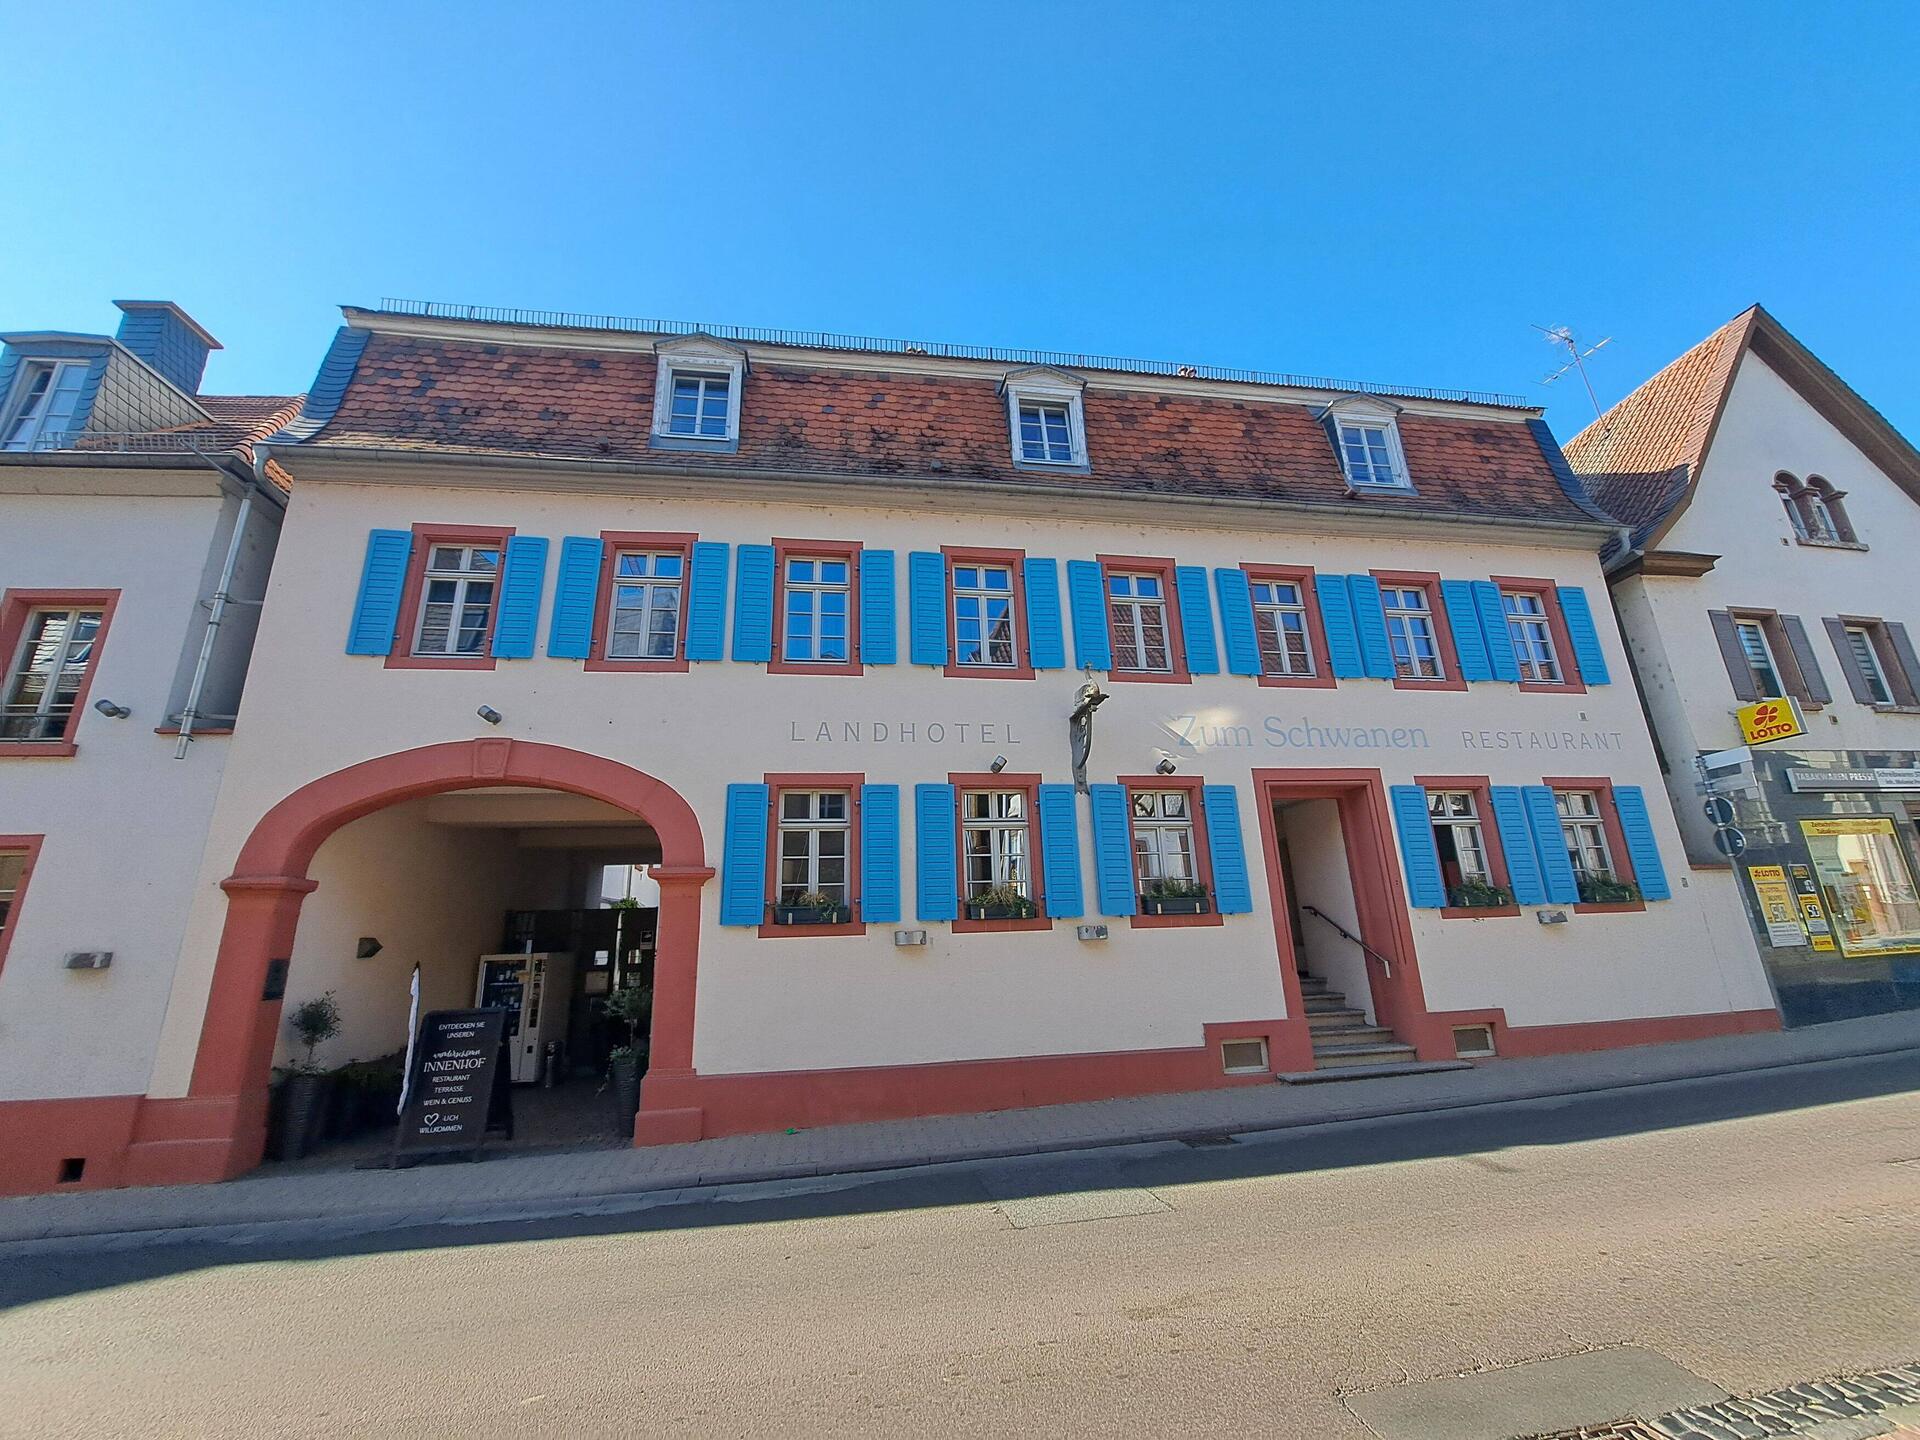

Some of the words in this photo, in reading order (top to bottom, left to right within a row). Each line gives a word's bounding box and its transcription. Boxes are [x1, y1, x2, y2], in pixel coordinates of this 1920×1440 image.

[791, 721, 1021, 744] LANDHOTEL
[1177, 715, 1255, 747] Zum
[1263, 716, 1431, 748] Schwanen
[1750, 723, 1792, 740] LOTTO
[1461, 731, 1622, 750] RESTAURANT
[1849, 772, 1875, 781] PRESSE
[1761, 869, 1781, 877] LOTTO
[439, 1022, 476, 1030] ENTDECKEN
[447, 1031, 475, 1039] UNSEREN
[424, 1058, 486, 1073] INNENHOF
[432, 1074, 470, 1083] RESTAURANT
[434, 1085, 464, 1093] TERRASSE
[448, 1096, 473, 1105] GENUSS
[420, 1125, 462, 1133] WILLKOMMEN
